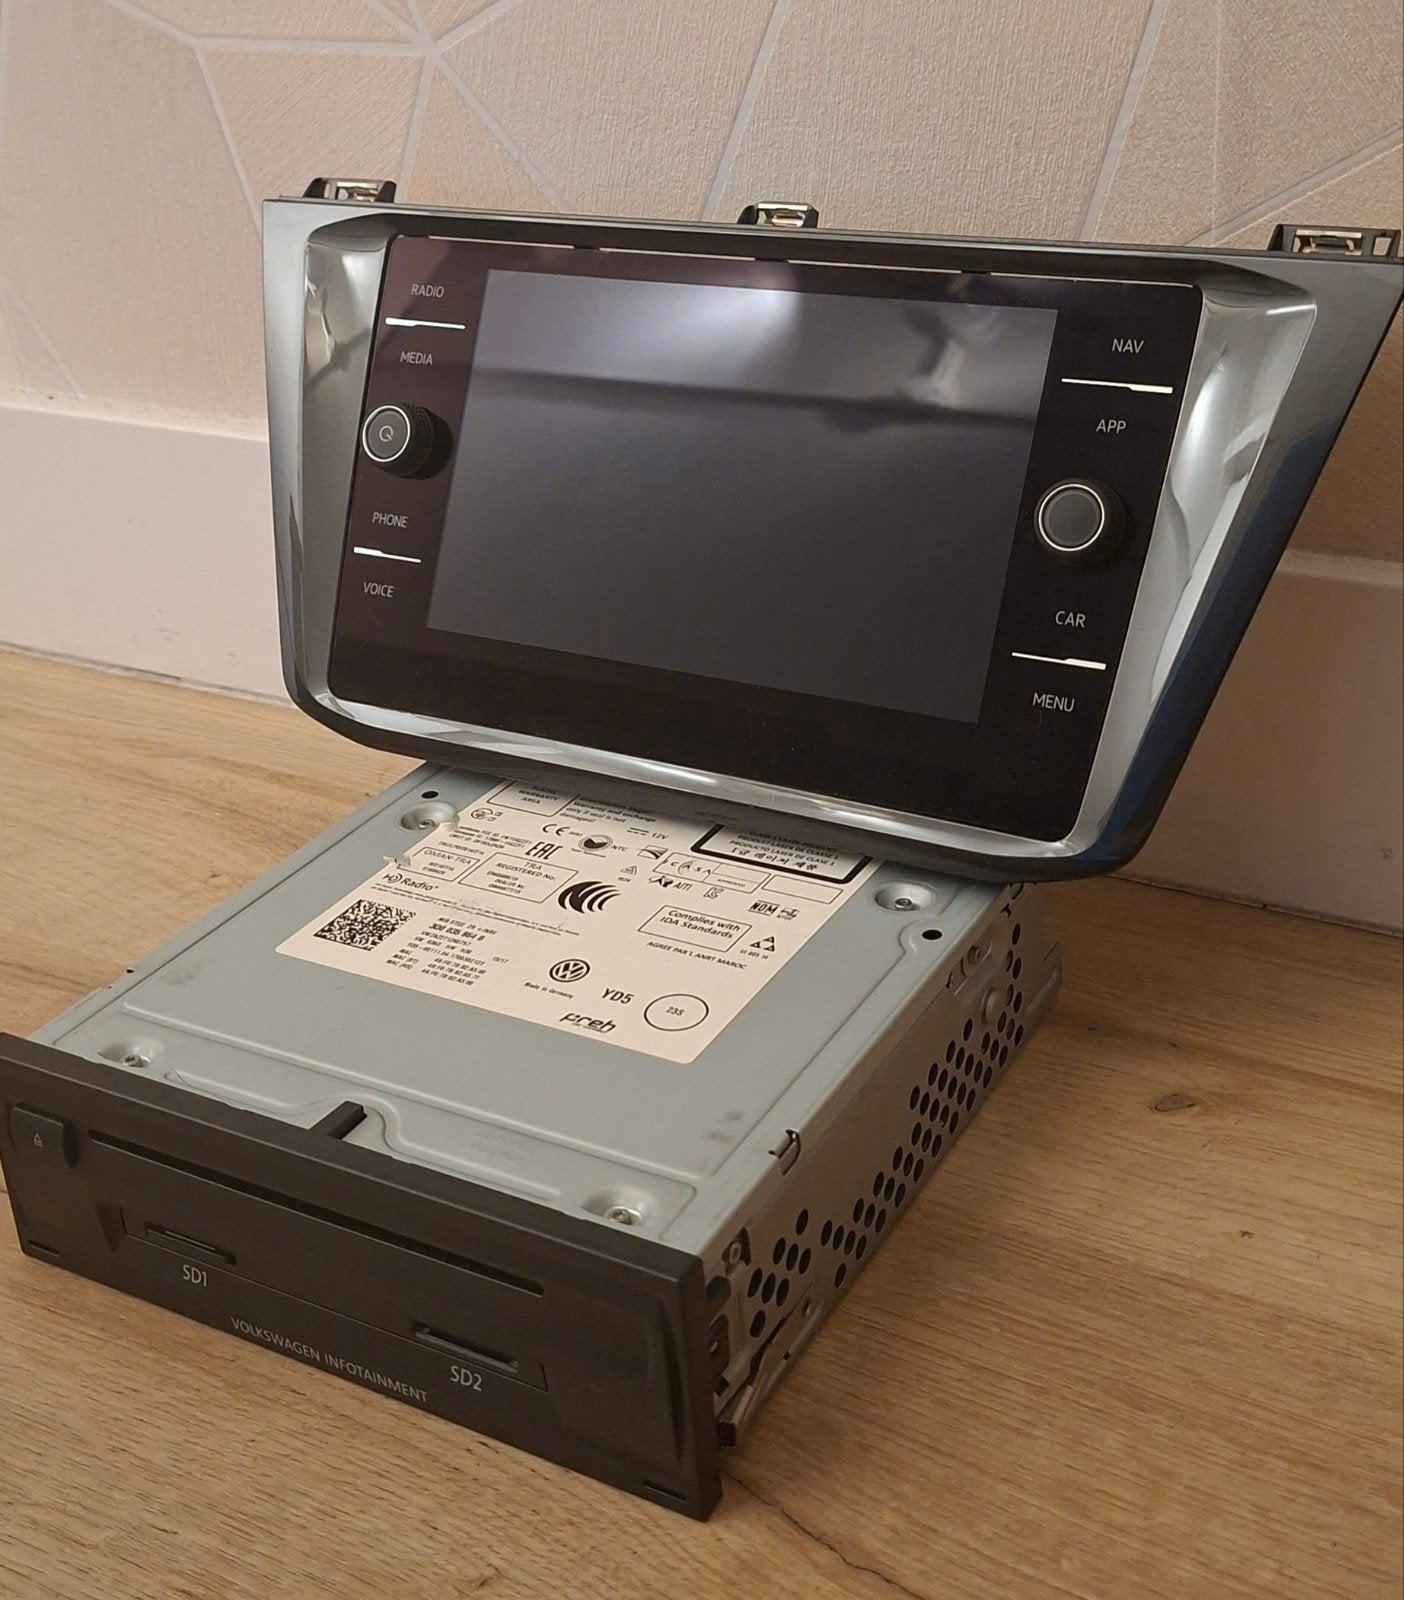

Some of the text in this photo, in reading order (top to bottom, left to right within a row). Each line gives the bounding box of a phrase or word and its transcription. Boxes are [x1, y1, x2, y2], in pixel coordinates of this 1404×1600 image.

[411, 283, 445, 299] RADIO
[1112, 338, 1145, 354] NAV
[400, 350, 433, 366] MEDIA
[1096, 418, 1128, 435] APP
[372, 511, 408, 529] PHONE
[363, 581, 395, 598] VOICE
[1055, 610, 1087, 629] CAR
[1032, 691, 1075, 713] MENU
[573, 802, 606, 812] Warranty
[622, 813, 656, 822] exchange
[729, 840, 770, 852] PRODUCTO
[770, 849, 794, 857] LASER
[771, 842, 794, 850] LASER
[424, 850, 471, 865] OMAN-TRA
[524, 862, 542, 870] TRA
[496, 863, 542, 877] REGISTERED
[400, 878, 433, 891] Radio
[750, 901, 779, 914] NOM
[660, 916, 733, 938] IDA Standards
[668, 910, 740, 931] Complies with
[716, 958, 747, 969] MAROC
[548, 988, 574, 999] Germany
[602, 988, 634, 1004] YD5
[560, 1013, 616, 1033] preh
[181, 1263, 208, 1287] SD1
[230, 1316, 428, 1403] VOLKSWAGEN INFOTAINMENT
[450, 1365, 483, 1391] SD2
